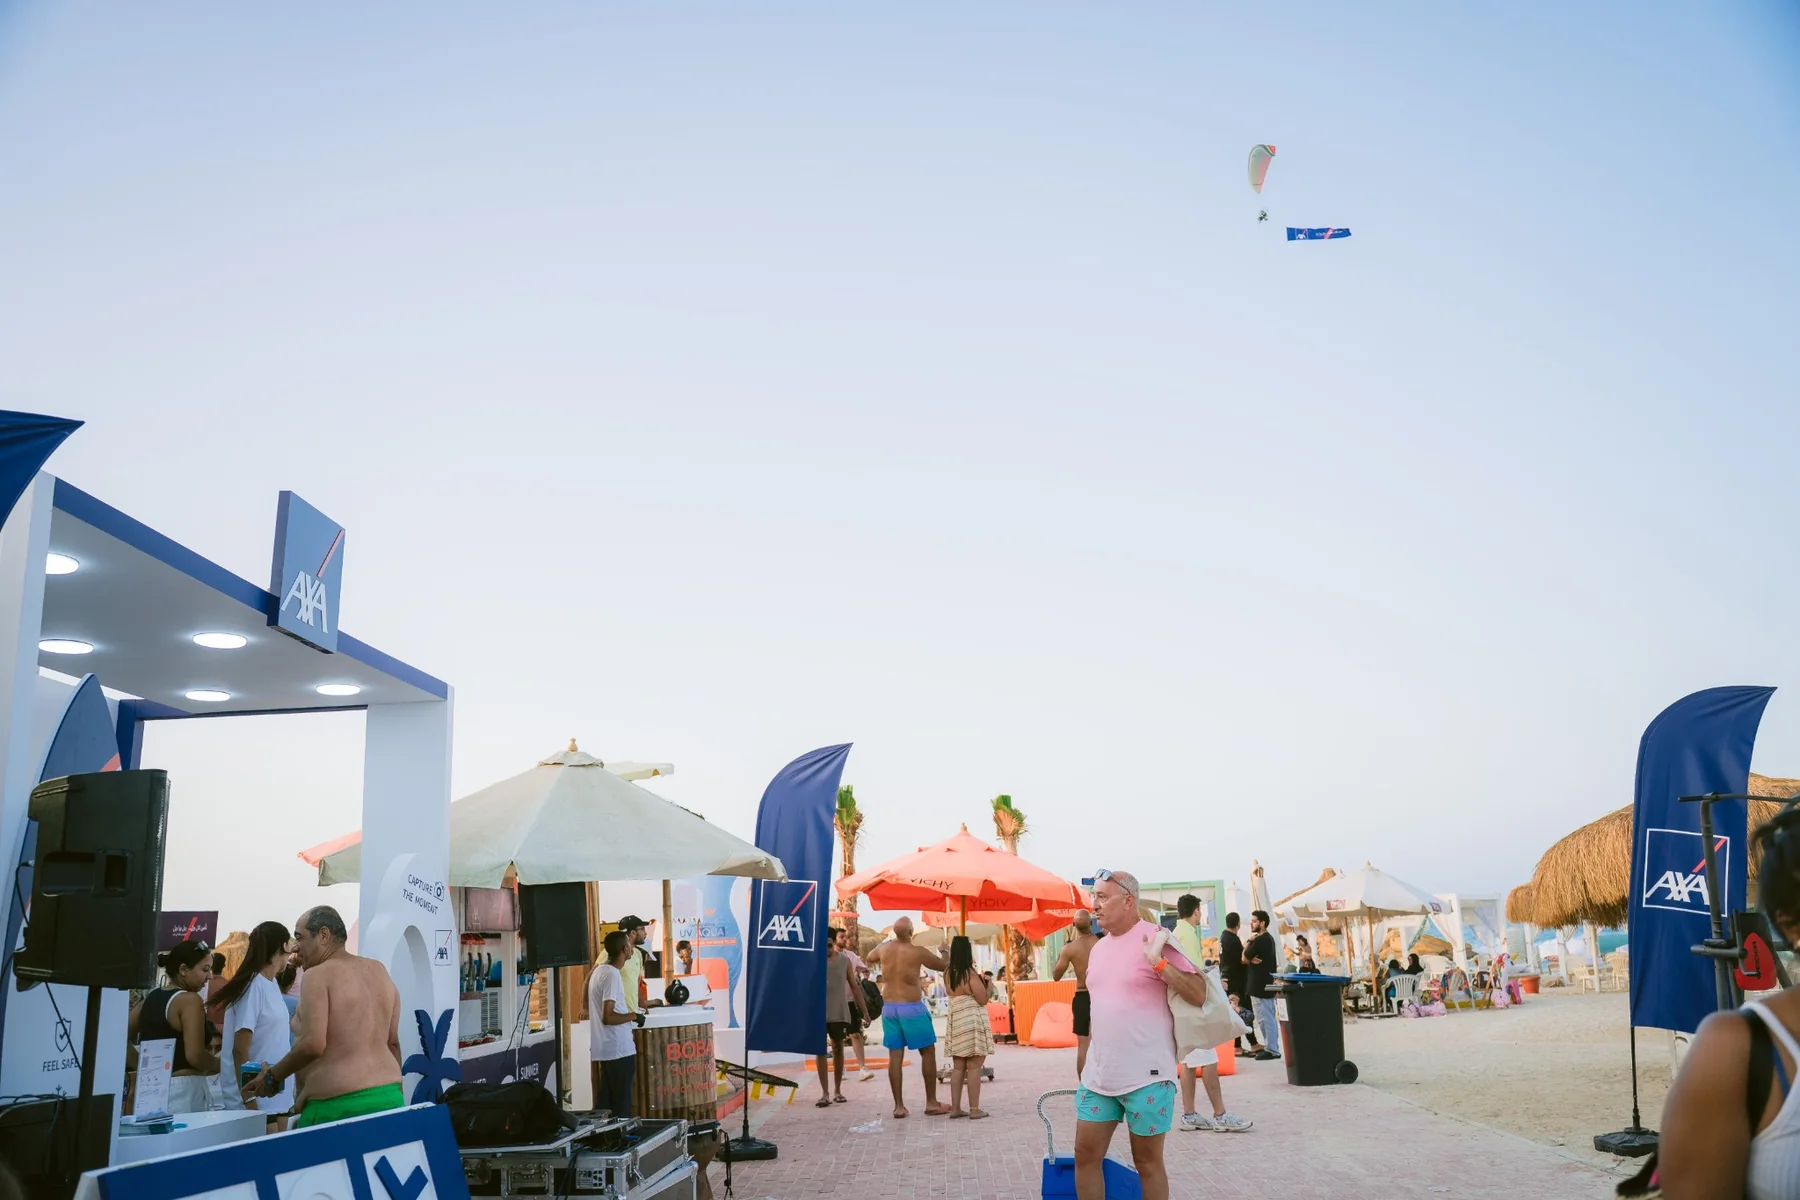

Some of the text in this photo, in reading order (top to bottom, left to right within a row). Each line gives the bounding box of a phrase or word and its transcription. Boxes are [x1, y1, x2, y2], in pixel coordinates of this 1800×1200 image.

[280, 570, 328, 634] AXA
[408, 874, 433, 895] CAPTURE
[911, 878, 954, 890] VICHY
[1645, 870, 1710, 906] AXA
[403, 888, 438, 915] THE MOMENT
[680, 929, 693, 938] UV
[759, 915, 805, 942] AXA
[435, 946, 448, 960] AXA
[666, 1040, 713, 1060] BOBA
[43, 1058, 79, 1072] FEEL SAFE
[520, 1063, 539, 1079] SUMMER
